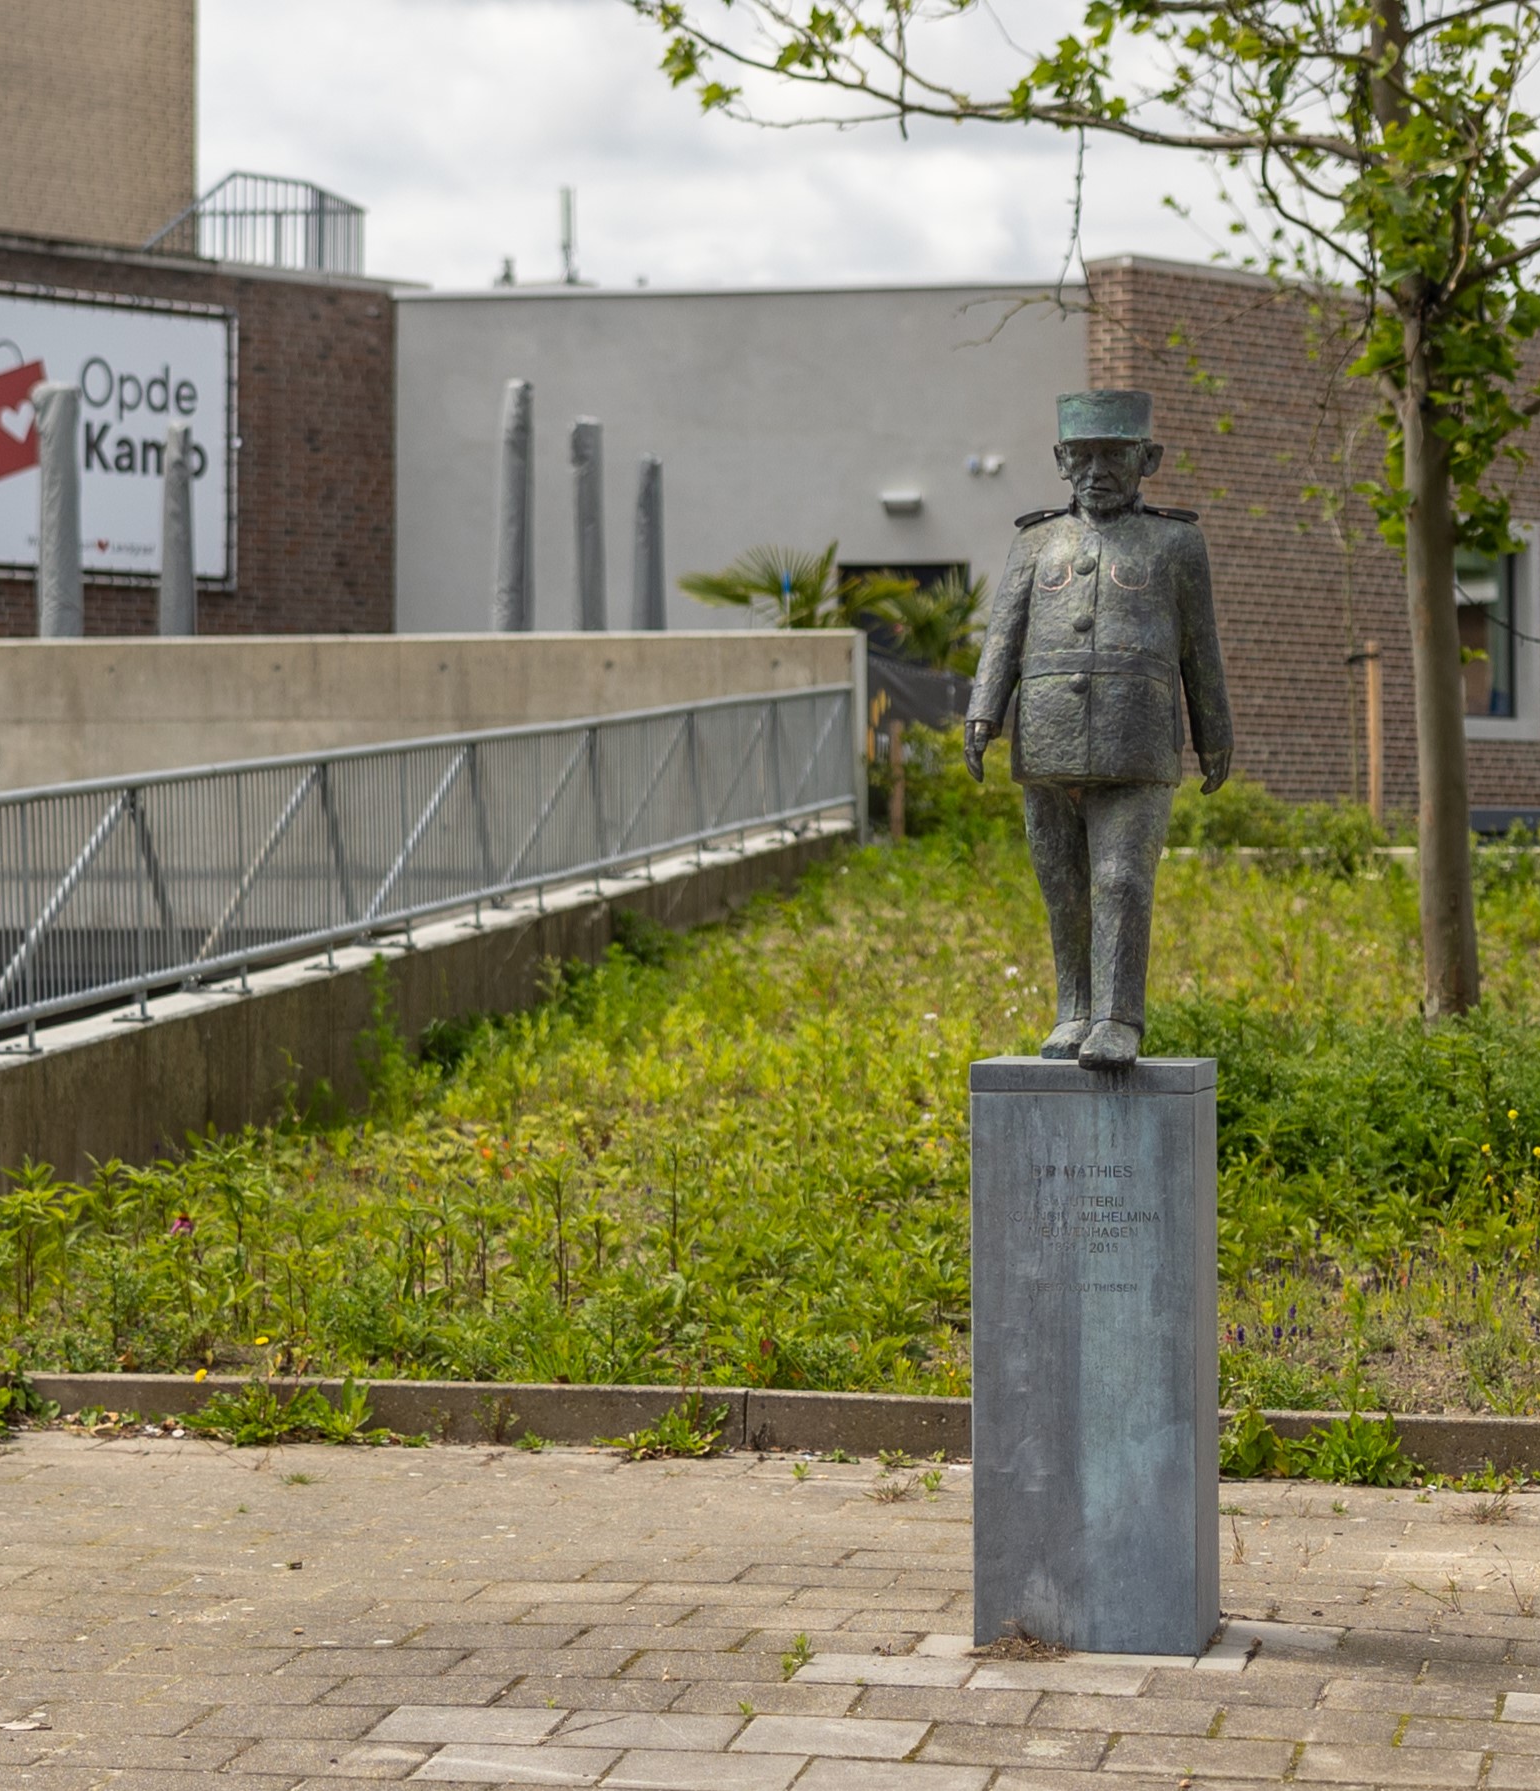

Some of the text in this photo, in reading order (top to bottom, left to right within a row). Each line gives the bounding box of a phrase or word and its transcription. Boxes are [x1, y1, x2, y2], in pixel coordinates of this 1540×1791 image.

[1063, 1164, 1133, 1178] MATHIES
[1006, 1210, 1161, 1222] KONGIN WILHELMINA
[1089, 1241, 1119, 1253] 2015
[1093, 1282, 1138, 1292] THISSEN
